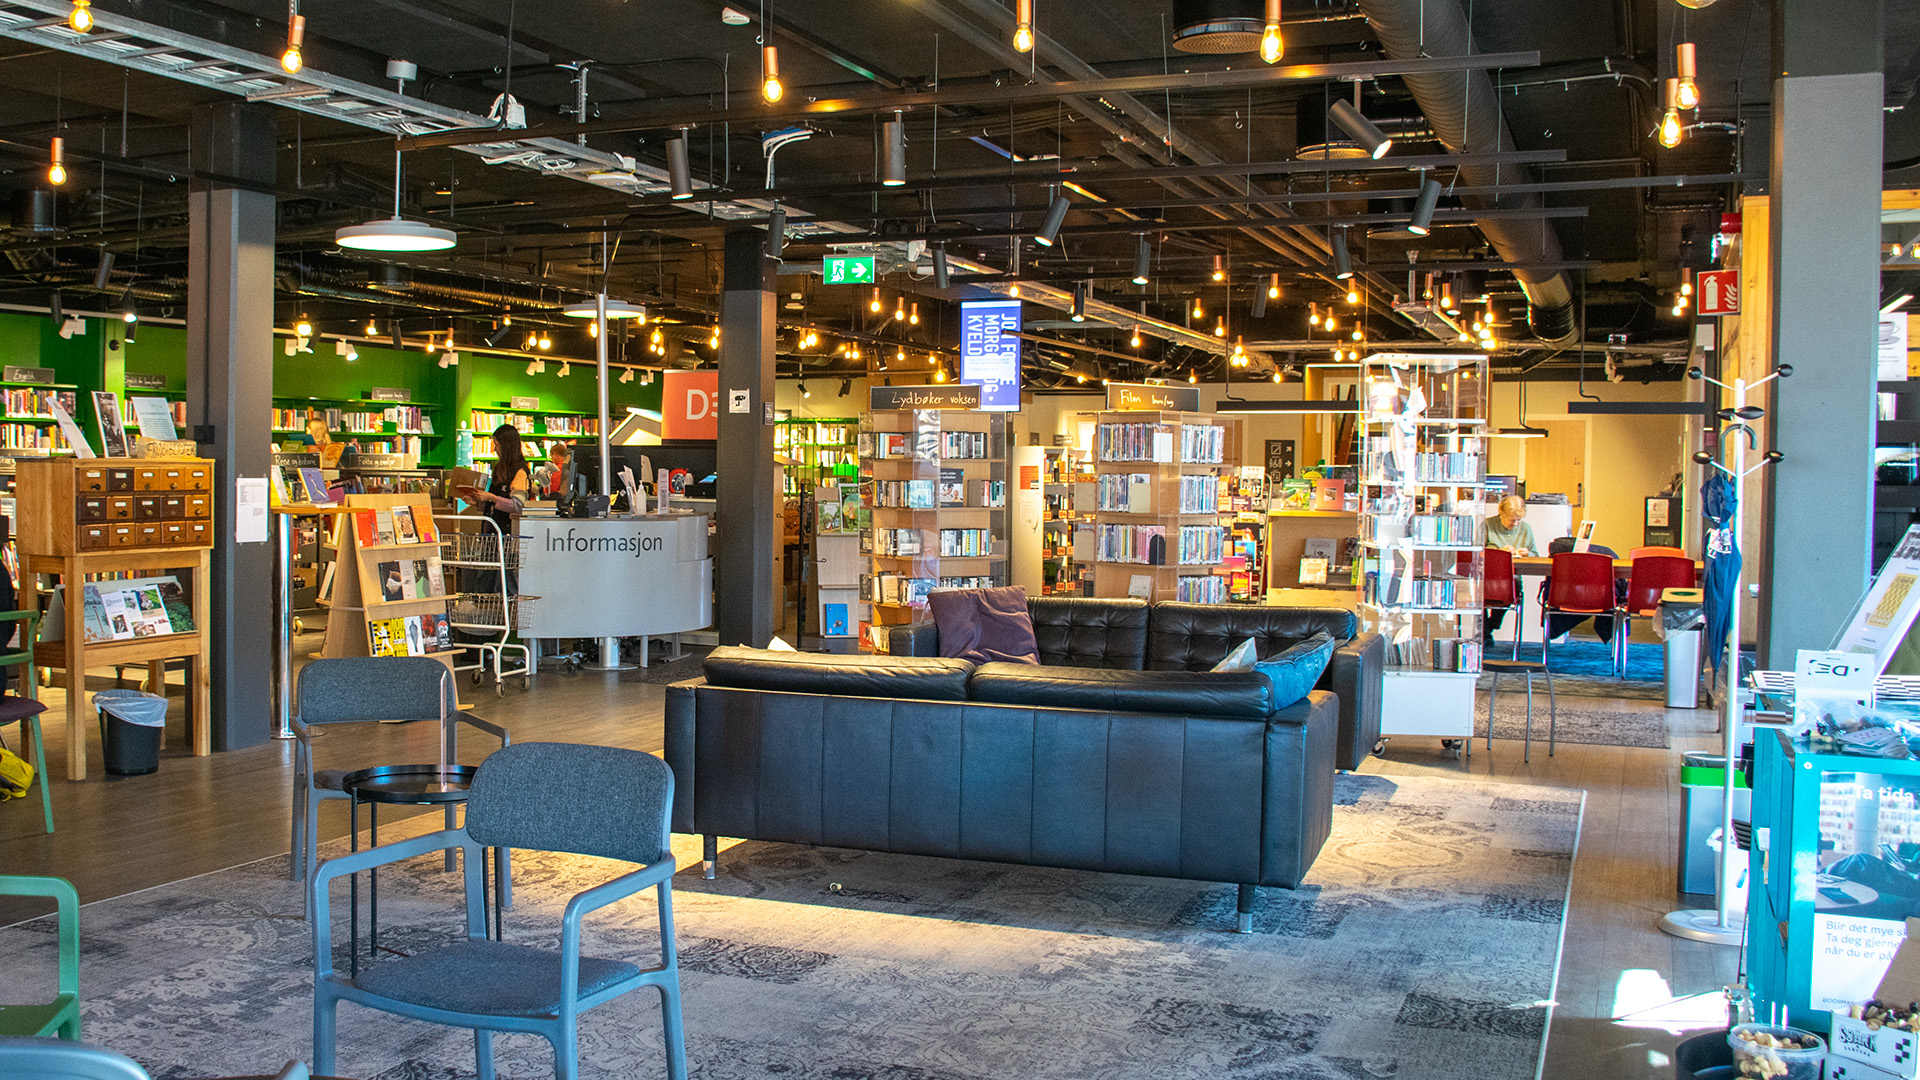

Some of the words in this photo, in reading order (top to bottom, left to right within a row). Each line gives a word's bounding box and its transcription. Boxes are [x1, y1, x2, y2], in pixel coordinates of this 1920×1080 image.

[967, 315, 983, 356] KVELD
[891, 391, 944, 408] Lydbøker
[949, 391, 977, 405] voksen
[1120, 389, 1142, 405] Film
[546, 528, 662, 558] Informasjon
[1856, 785, 1873, 800] Ta
[1878, 787, 1915, 803] tida
[1826, 921, 1846, 931] Blir
[1849, 924, 1868, 933] det
[1871, 927, 1894, 937] mye
[1826, 933, 1838, 942] Ta
[1841, 935, 1862, 947] deg
[1825, 945, 1844, 955] når
[1847, 949, 1860, 957] du
[1863, 951, 1876, 959] er
